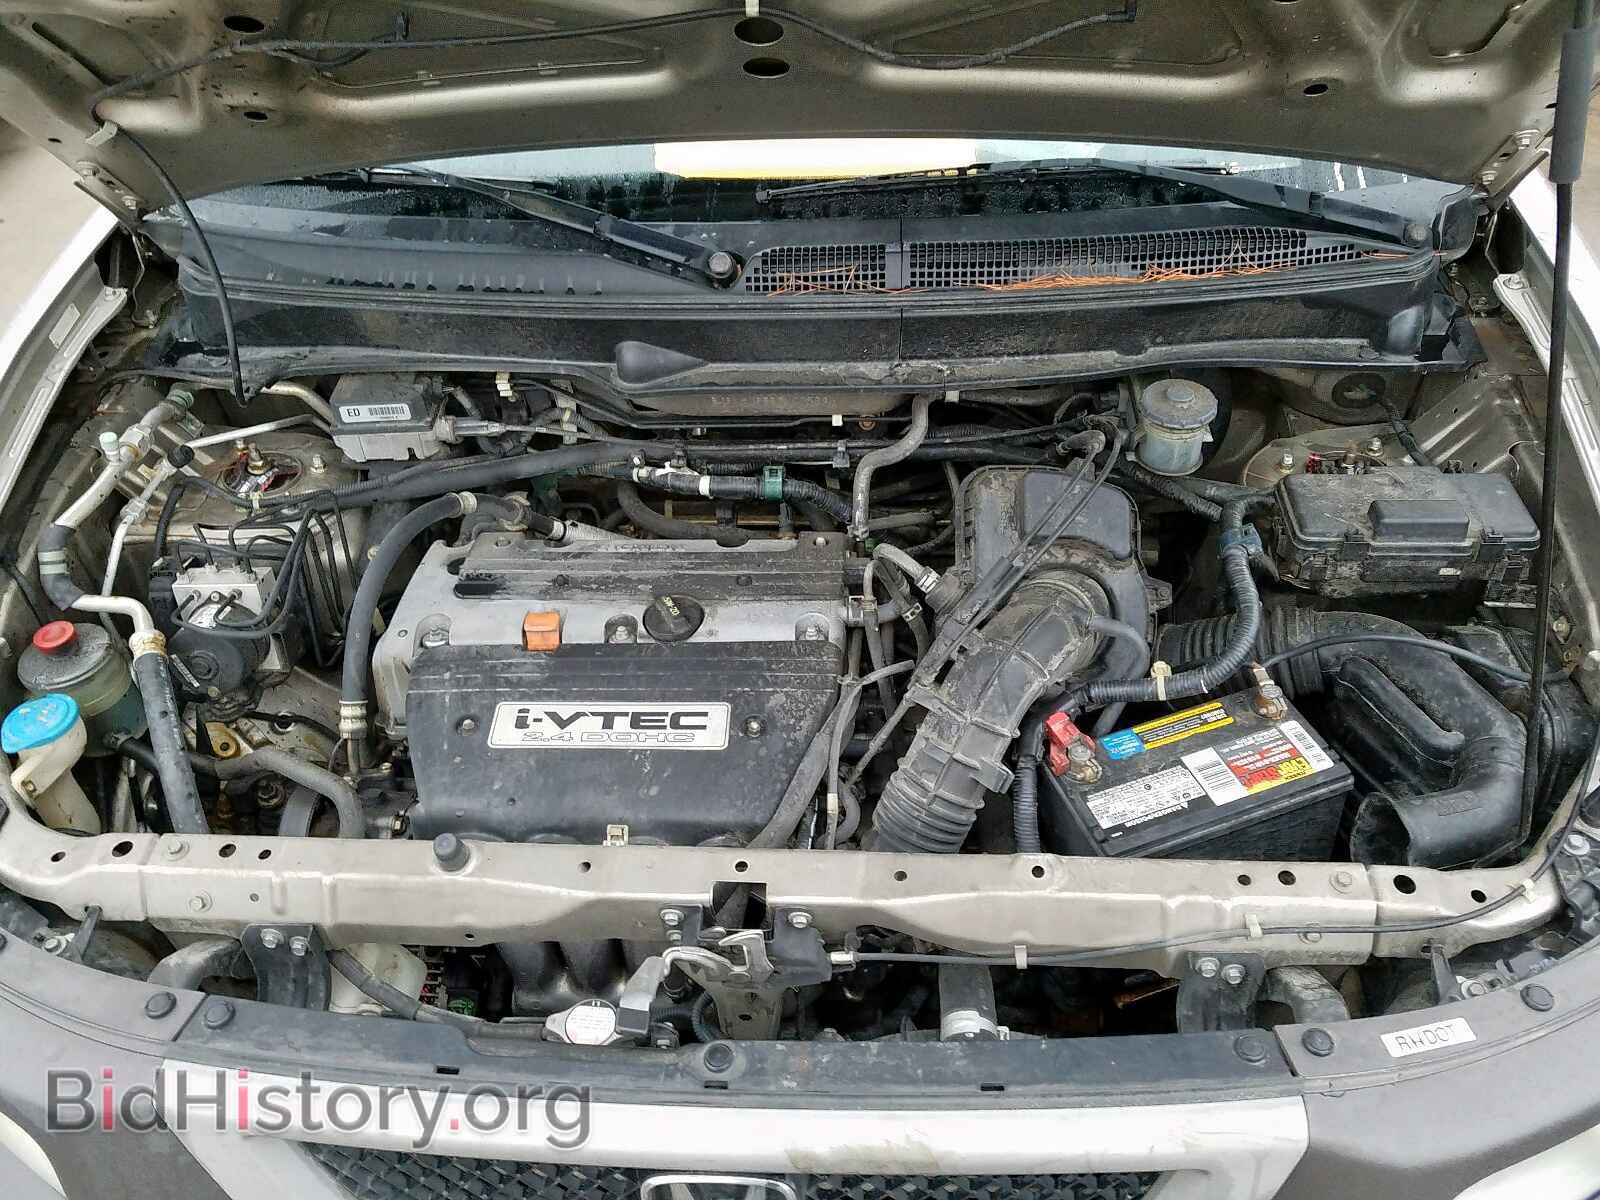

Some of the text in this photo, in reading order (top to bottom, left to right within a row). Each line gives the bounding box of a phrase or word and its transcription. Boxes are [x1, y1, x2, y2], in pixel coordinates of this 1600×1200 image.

[514, 708, 709, 730] i-VTEC
[521, 731, 696, 743] 2.4 DOHC
